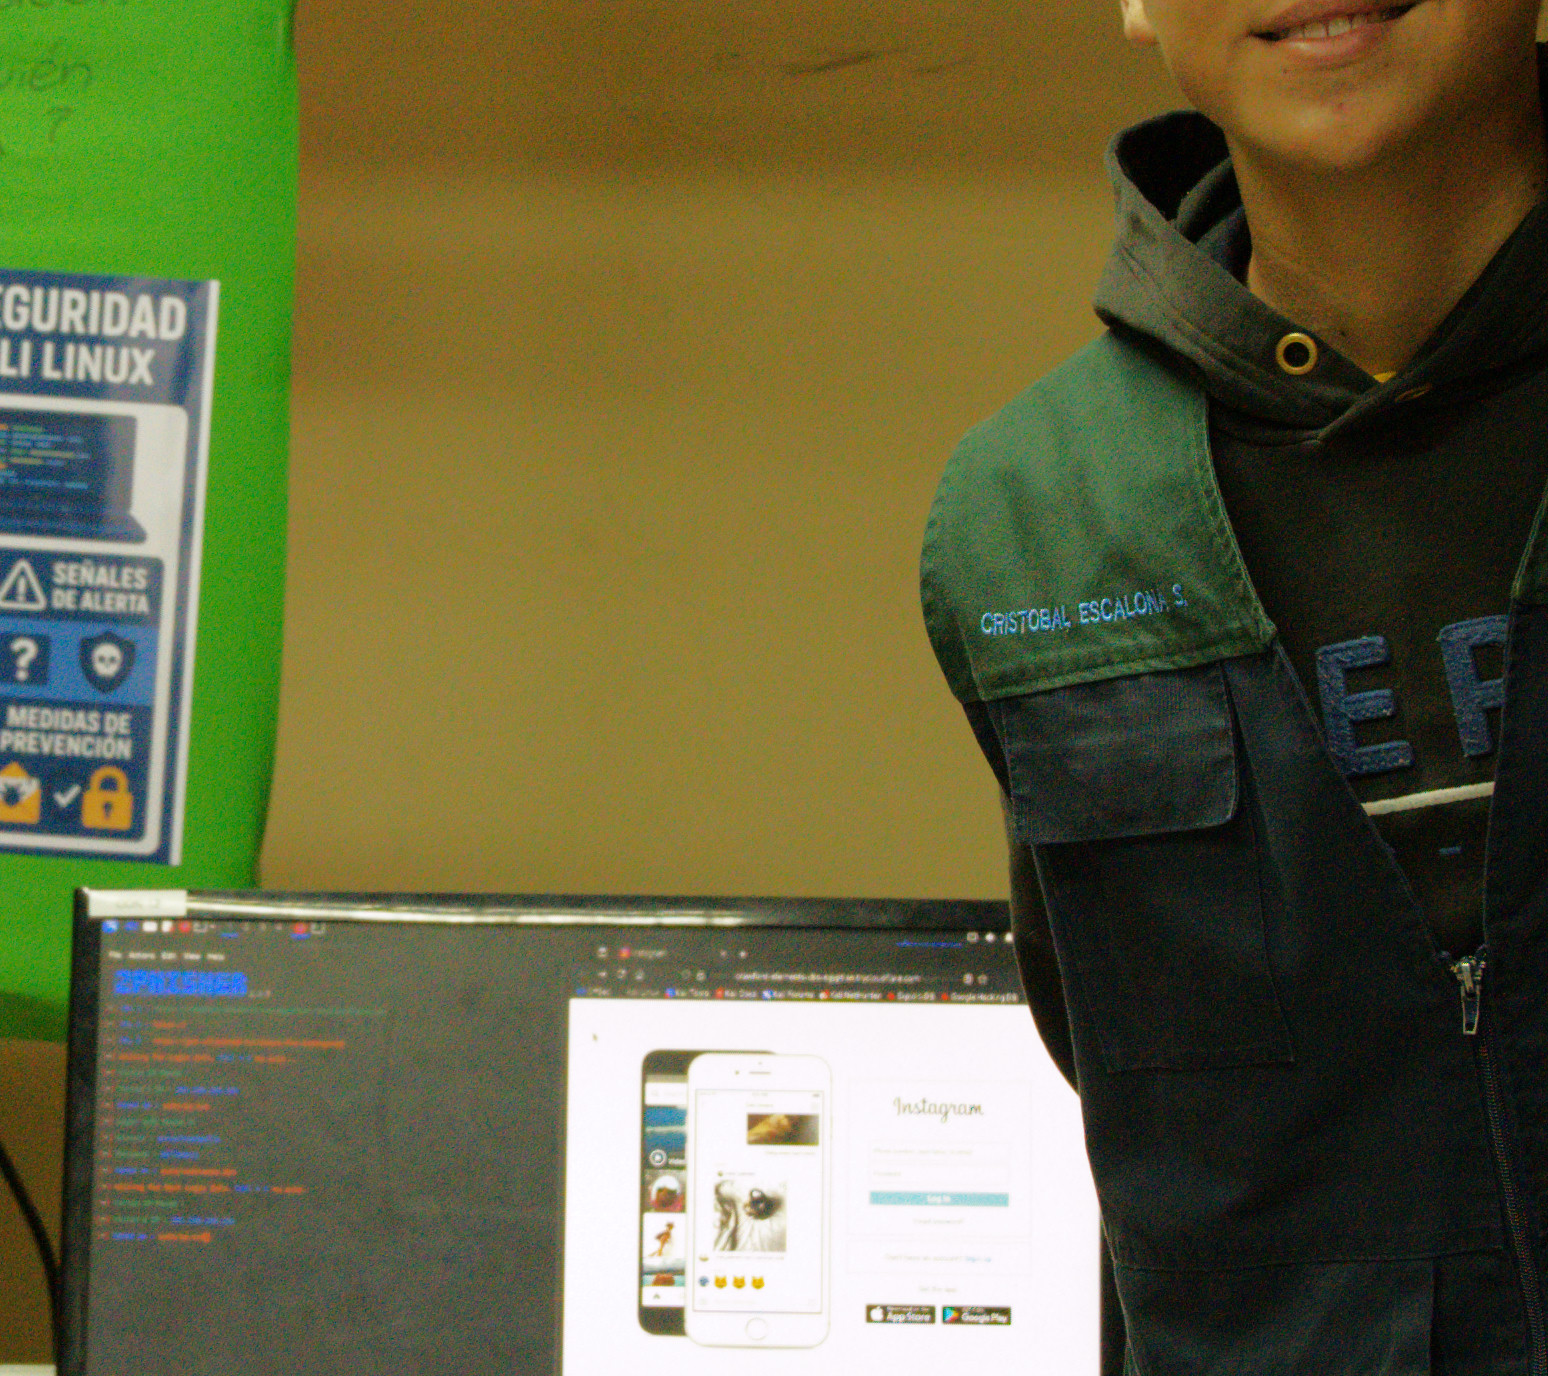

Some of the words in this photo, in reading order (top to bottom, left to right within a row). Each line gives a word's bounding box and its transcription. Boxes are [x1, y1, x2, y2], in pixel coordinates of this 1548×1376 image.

[41, 340, 156, 388] LINUX
[52, 559, 149, 591] SEÑALES
[51, 588, 77, 610] DE
[79, 590, 151, 616] ALERTA
[980, 604, 1072, 637] CRISTOBAL
[1078, 589, 1170, 625] ESCALONA
[1172, 583, 1189, 608] S.
[6, 704, 100, 733] MEDIDAS
[103, 711, 133, 736] DE
[893, 1096, 985, 1124] Instagram
[886, 1311, 906, 1324] App
[907, 1312, 932, 1323] Store
[961, 1312, 990, 1325] Google
[990, 1313, 1009, 1325] Play
